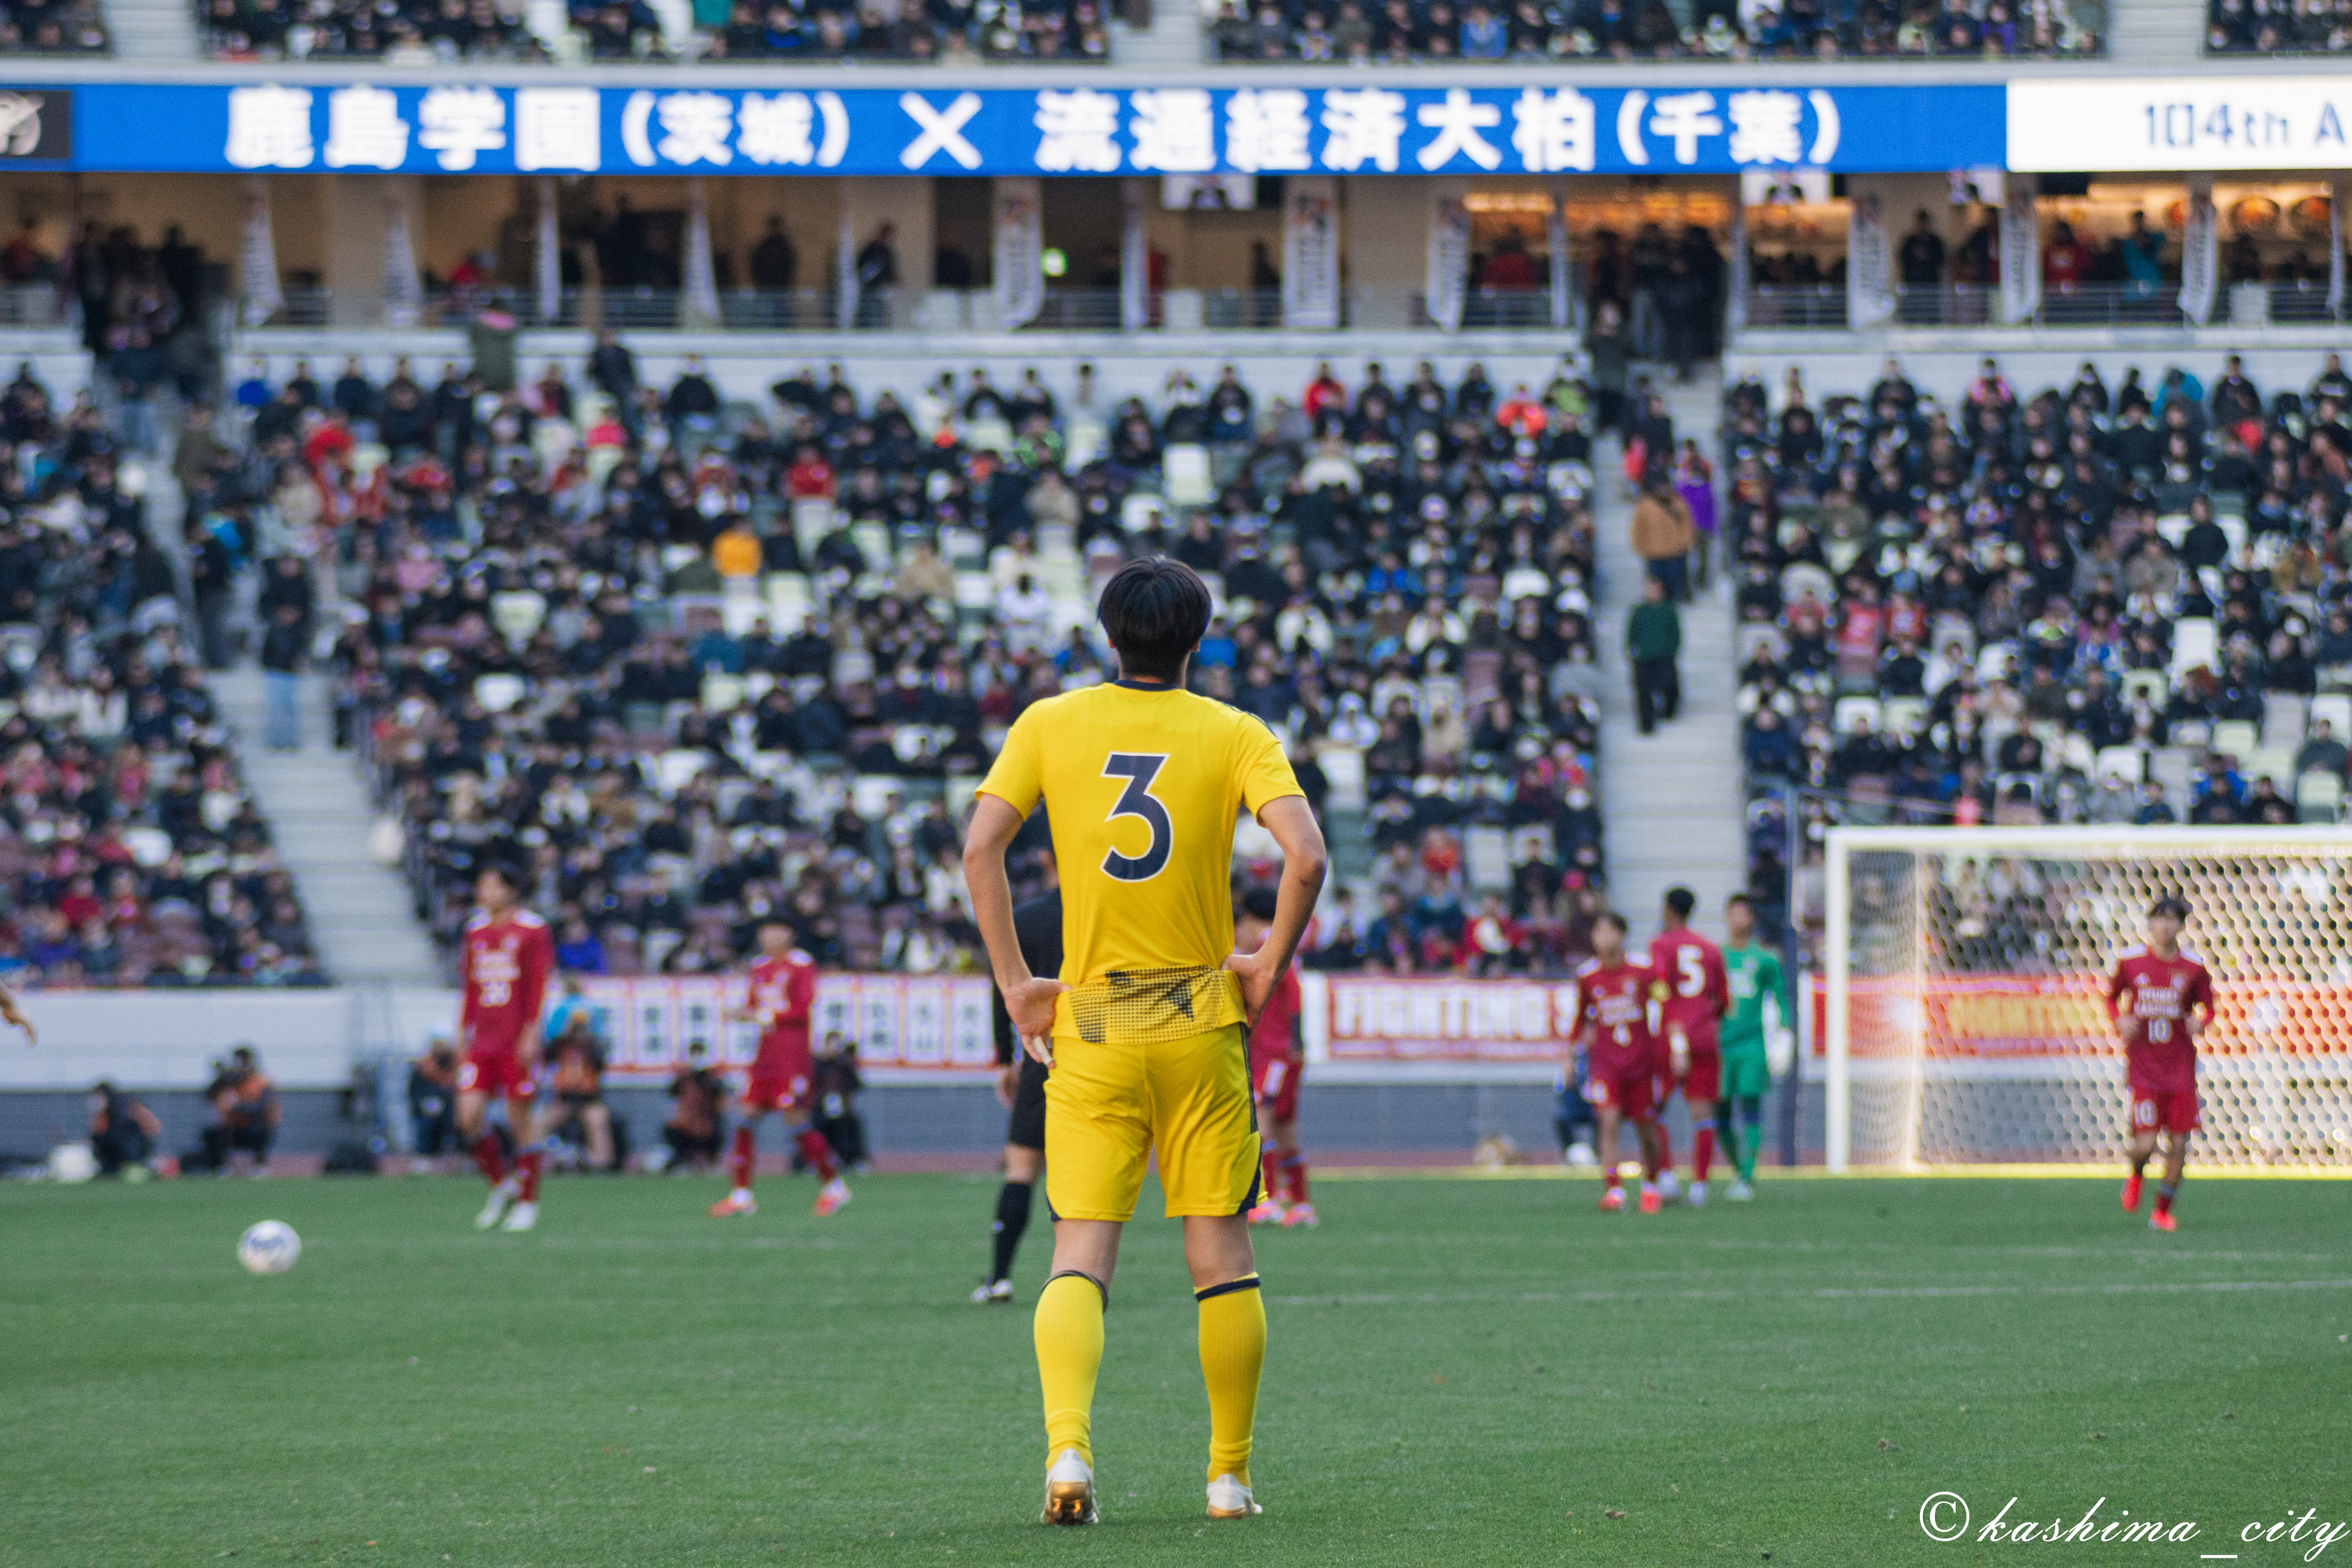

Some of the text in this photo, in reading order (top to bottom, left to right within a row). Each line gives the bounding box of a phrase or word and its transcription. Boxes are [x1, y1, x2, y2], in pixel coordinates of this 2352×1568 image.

[2145, 103, 2288, 146] 104th
[1100, 751, 1174, 883] 3
[1677, 945, 1706, 997] 5
[2148, 1019, 2172, 1043] 10
[2134, 1100, 2157, 1125] 10
